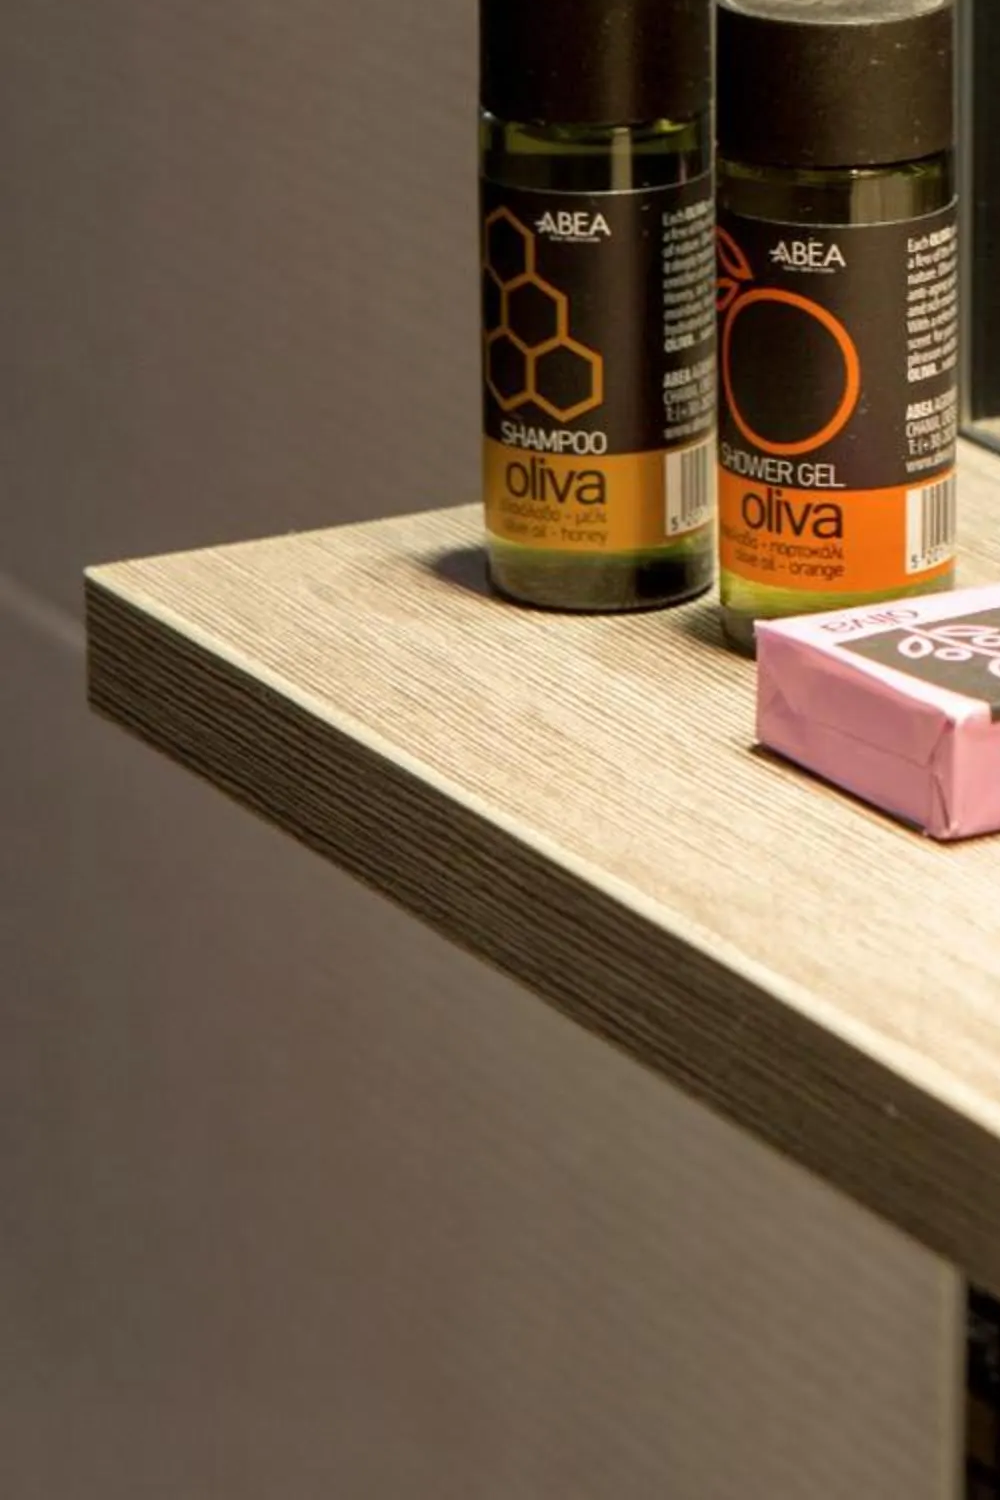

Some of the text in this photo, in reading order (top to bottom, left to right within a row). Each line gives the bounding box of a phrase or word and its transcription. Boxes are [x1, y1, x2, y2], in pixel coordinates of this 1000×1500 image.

[537, 212, 611, 237] ABEA
[770, 240, 847, 267] ABEA
[501, 419, 607, 455] SHAMPOO
[505, 456, 607, 506] oliva
[722, 442, 846, 489] SHOWER GEL
[741, 488, 843, 540] oliva
